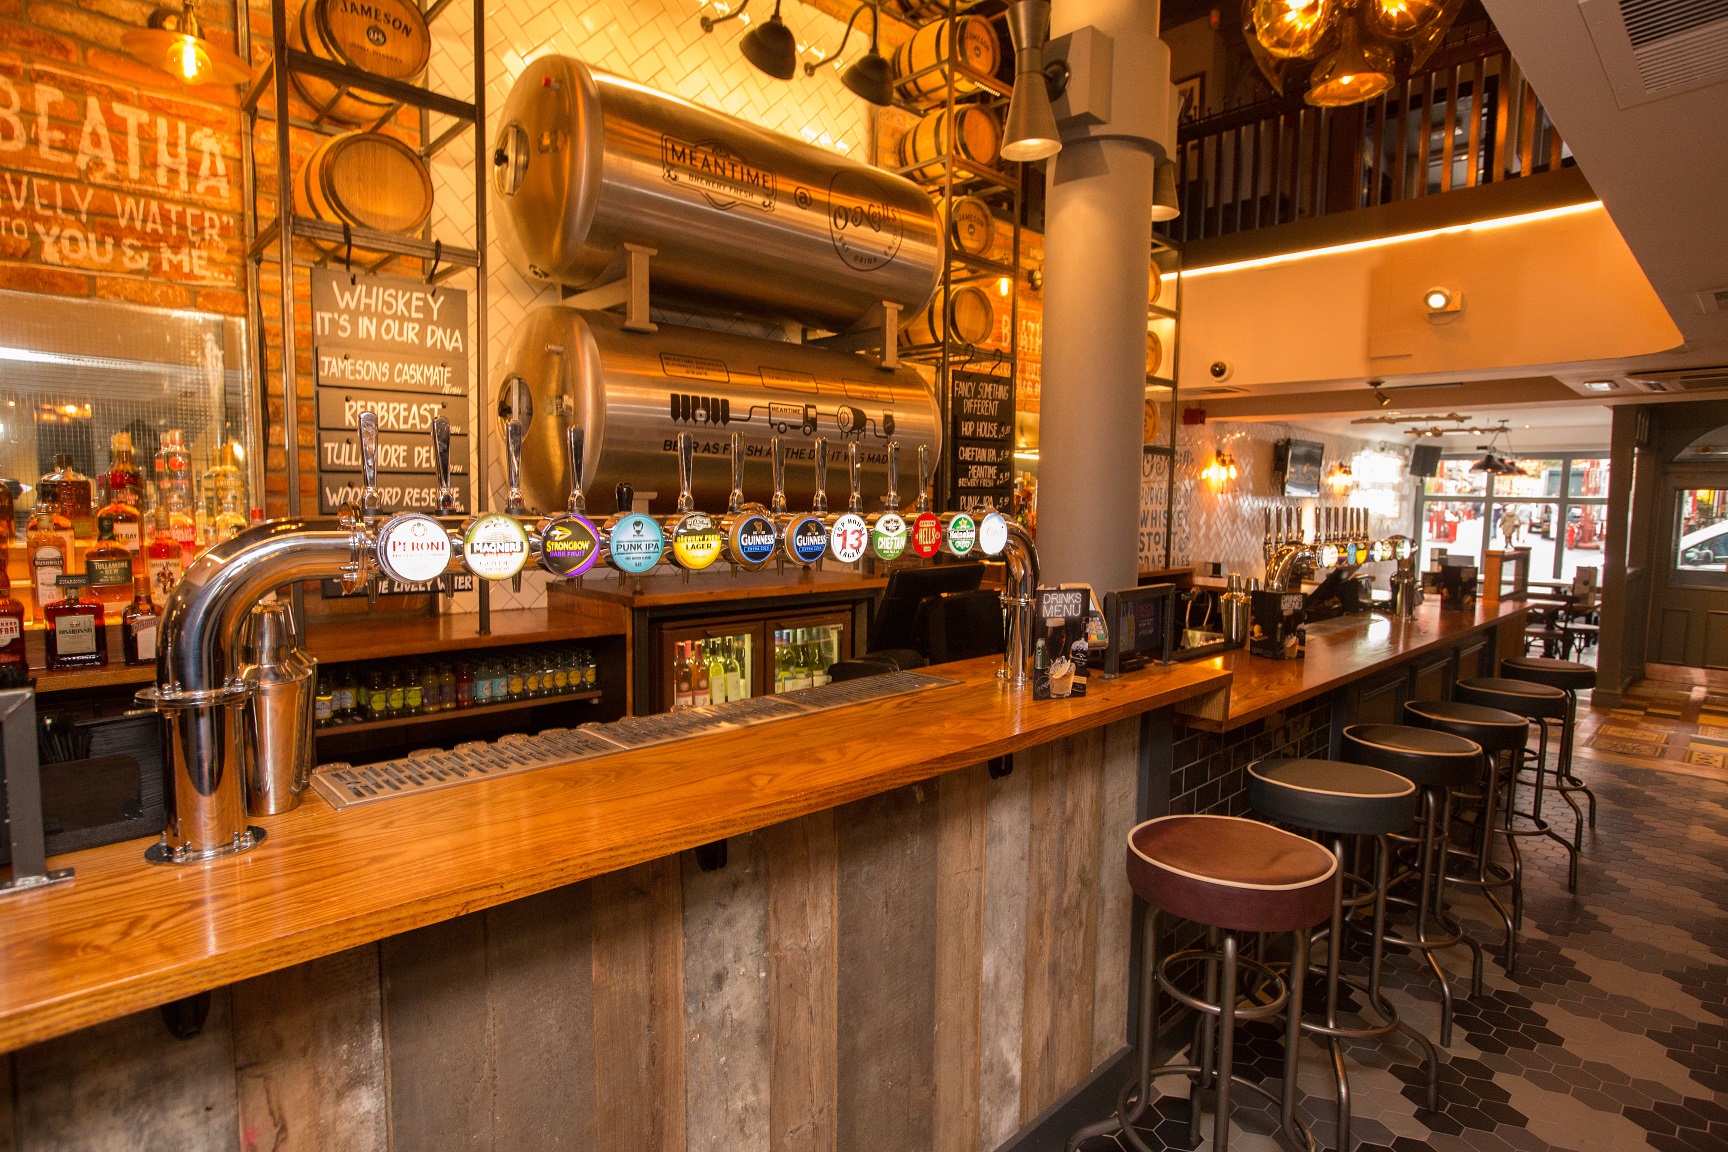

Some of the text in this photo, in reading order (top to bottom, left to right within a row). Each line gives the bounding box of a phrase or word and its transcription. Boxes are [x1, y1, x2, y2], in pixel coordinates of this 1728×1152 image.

[340, 1, 412, 37] JAMESON
[671, 143, 770, 191] MEANTIME
[688, 173, 754, 200] BREWERY FRESH
[832, 201, 898, 233] O'Neill's
[34, 222, 114, 266] YOU
[120, 238, 149, 270] &
[853, 255, 878, 265] DRINK
[332, 280, 445, 321] WHISKEY
[316, 311, 463, 352] IT'S IN OUR DNA
[319, 355, 452, 388] JAMESONS CASKMATE
[954, 380, 977, 398] FANCY
[978, 382, 1010, 400] SOMETHING
[770, 406, 802, 416] MEANTIME
[963, 399, 1000, 416] DIFFERENT
[961, 421, 975, 437] HOP
[976, 421, 998, 438] HOUSE
[663, 440, 700, 453] BER
[702, 442, 720, 455] AS
[784, 447, 806, 460] THE
[866, 453, 889, 465] MAD
[968, 465, 997, 479] MEANTIME
[741, 533, 775, 546] GUINNESS
[796, 535, 826, 547] GUINNESS
[837, 529, 864, 551] 13
[918, 528, 936, 545] HELLS
[393, 540, 445, 552] PERONI
[546, 540, 589, 552] STRONGBOW
[567, 550, 585, 558] FRUIT
[616, 542, 660, 552] PUNK IPA
[93, 561, 128, 571] TULLAMORE
[1043, 592, 1082, 605] DRINKS
[1042, 604, 1082, 618] MENU
